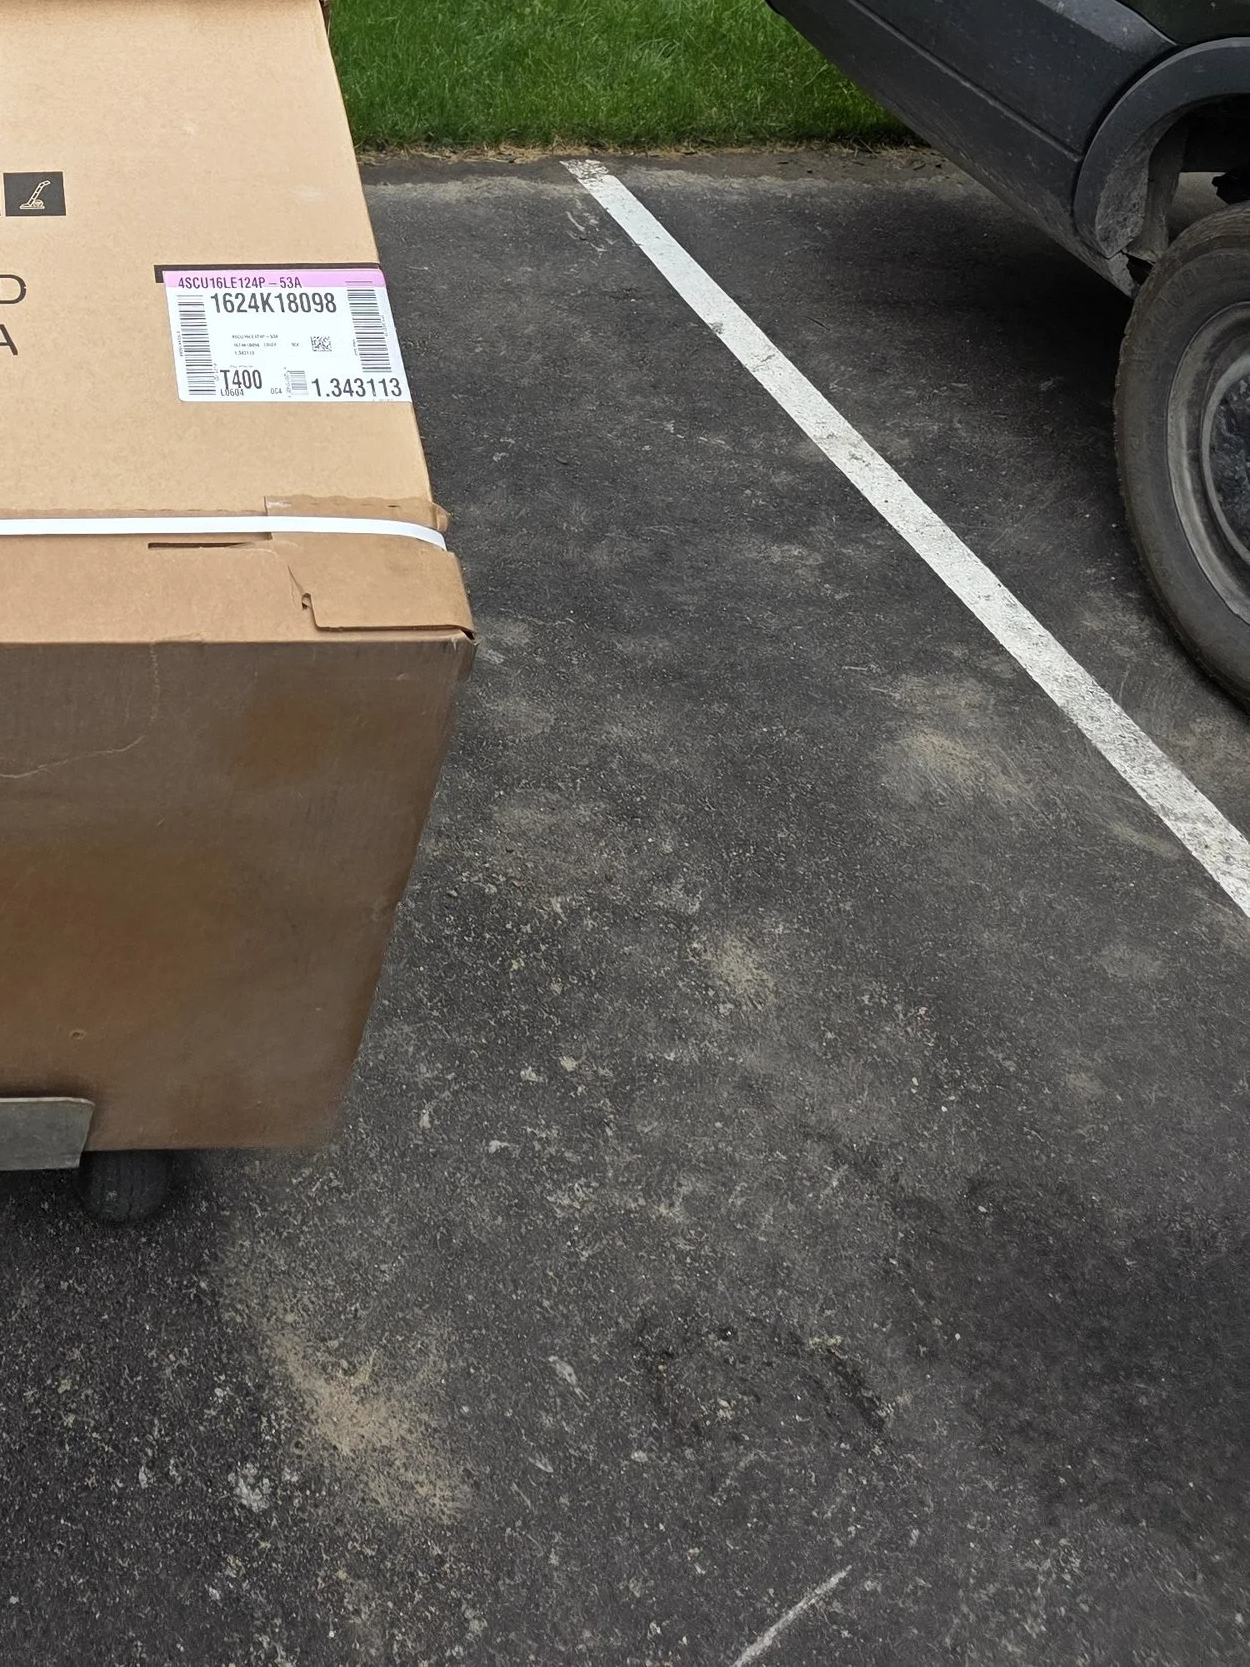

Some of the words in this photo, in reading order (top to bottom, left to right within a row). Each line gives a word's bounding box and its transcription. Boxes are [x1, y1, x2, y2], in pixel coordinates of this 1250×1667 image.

[210, 292, 337, 313] 1624K18098
[219, 369, 263, 390] T400
[311, 378, 403, 398] 1.343113
